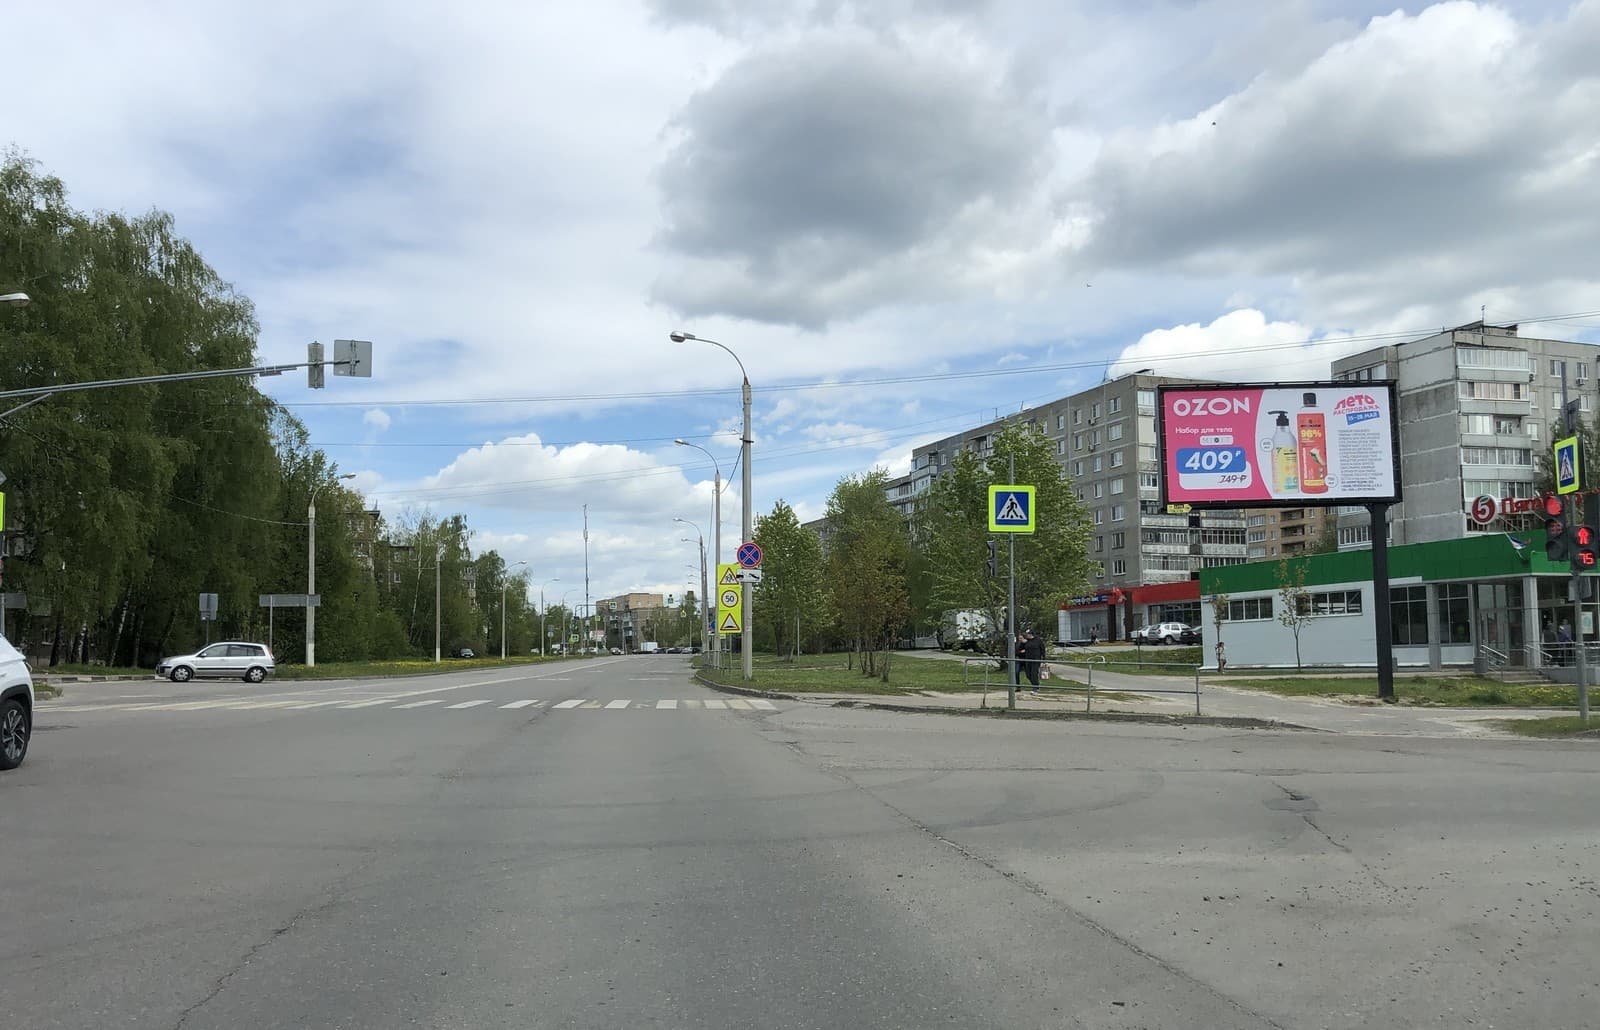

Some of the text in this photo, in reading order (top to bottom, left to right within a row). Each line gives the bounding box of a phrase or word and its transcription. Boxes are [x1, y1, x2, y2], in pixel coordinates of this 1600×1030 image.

[1173, 397, 1250, 416] OZON
[1175, 427, 1199, 435] Набор
[1185, 451, 1233, 470] 409
[1578, 552, 1594, 565] 75
[725, 595, 735, 603] 50
